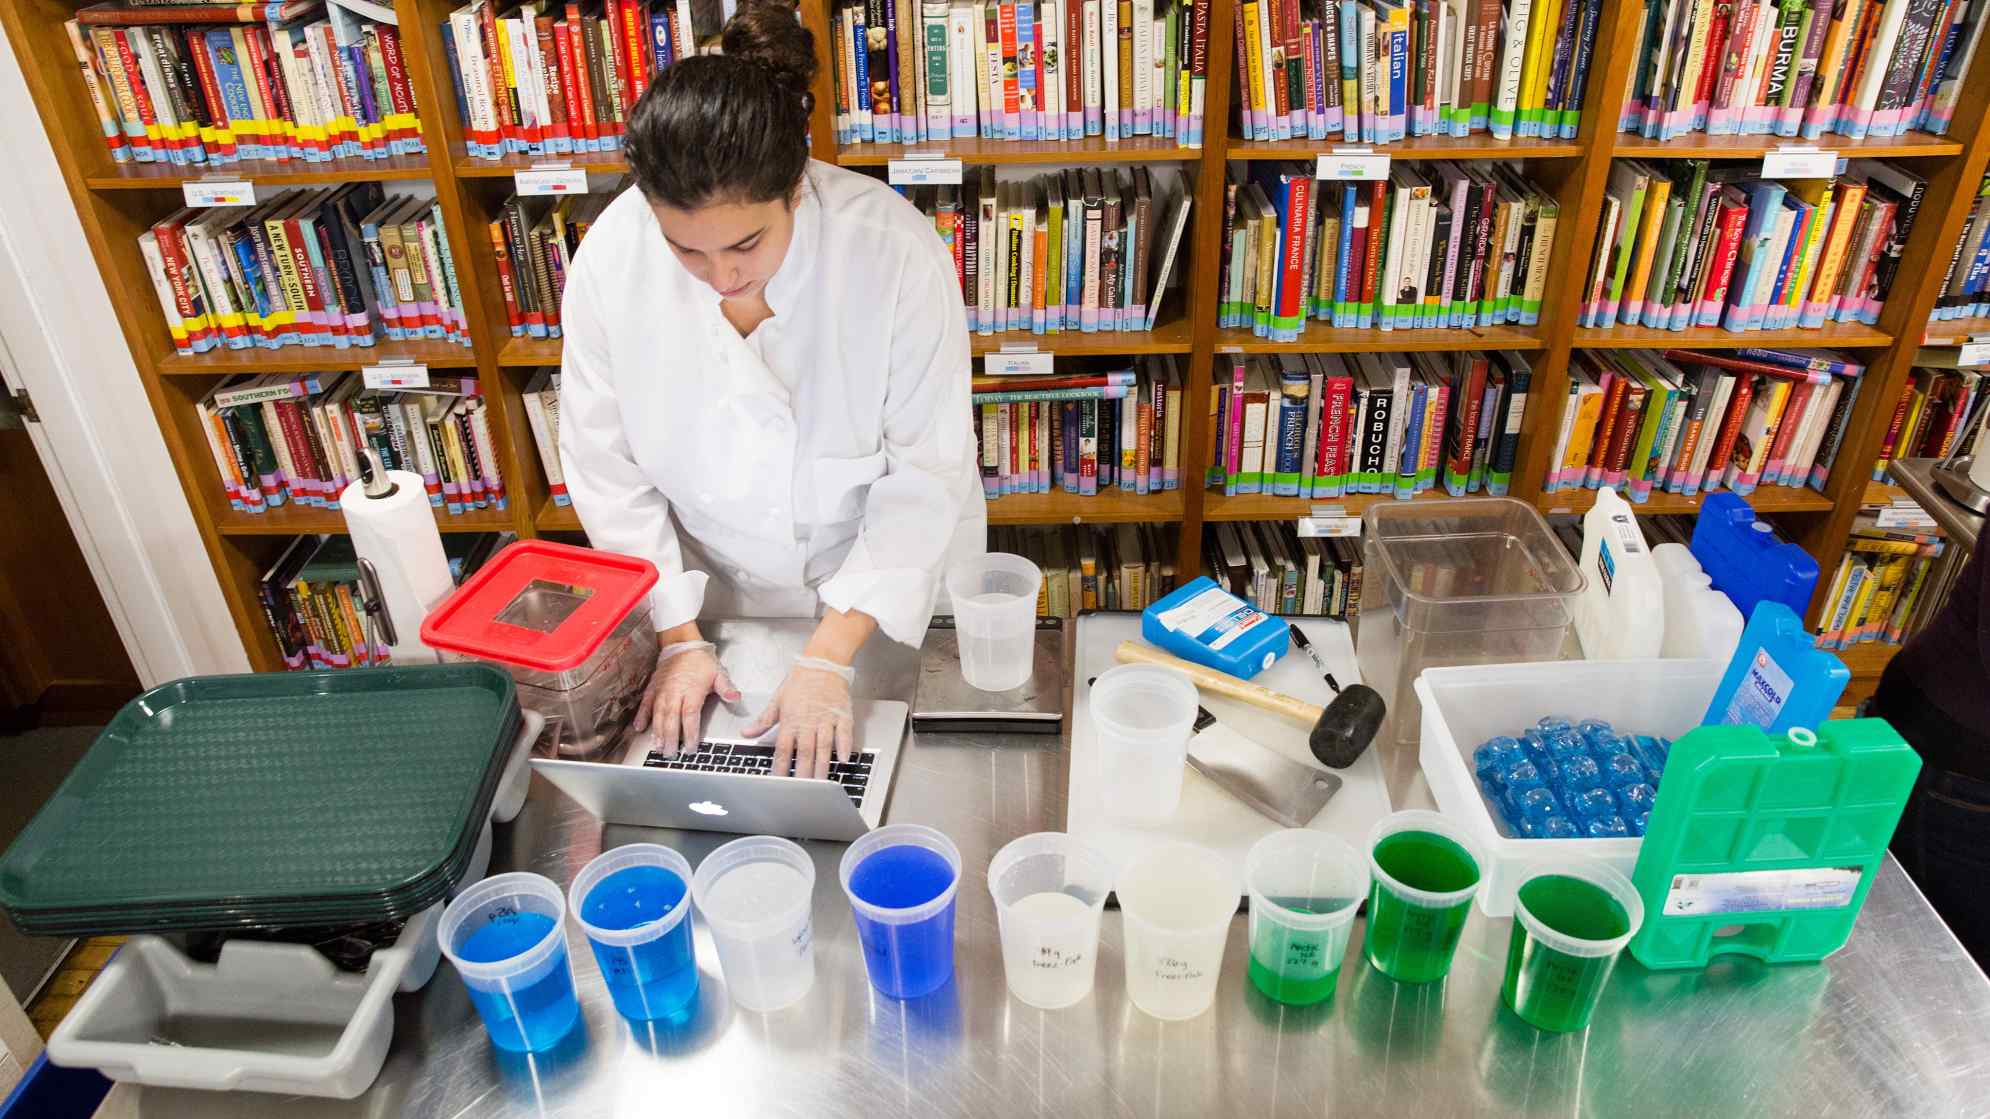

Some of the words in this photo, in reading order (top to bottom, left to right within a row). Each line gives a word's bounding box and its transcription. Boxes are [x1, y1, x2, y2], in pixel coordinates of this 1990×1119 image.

[624, 8, 636, 37] ANDREW
[1196, 2, 1208, 34] PASTA
[1488, 21, 1496, 29] LA
[1515, 3, 1529, 32] FIG
[1327, 33, 1336, 60] SHAPES
[1467, 25, 1476, 43] GREAT
[1486, 30, 1495, 50] BONNE
[1512, 39, 1523, 49] &
[1943, 29, 1959, 56] HOT
[382, 33, 400, 65] WORD
[391, 66, 401, 81] OF
[1194, 39, 1206, 72] ITALIA
[1392, 33, 1404, 79] italian
[1465, 44, 1474, 64] FRENCH
[1767, 23, 1799, 97] BURMA
[548, 65, 562, 95] Recipe
[1503, 56, 1521, 106] OLIVE
[1932, 59, 1948, 87] WOK
[1292, 185, 1305, 233] CULINARIA
[1908, 185, 1925, 215] nobu
[1731, 227, 1742, 242] Key
[1735, 213, 1746, 229] The
[1011, 230, 1019, 251] Italian
[1477, 217, 1490, 257] GIRARDET
[165, 255, 179, 276] NEW
[1010, 252, 1018, 277] Cooking
[1289, 235, 1301, 271] FRANCE
[272, 232, 285, 252] NEW
[279, 254, 293, 276] TURN
[288, 281, 305, 312] SOUTH
[294, 246, 315, 298] SOUTHERN
[1107, 273, 1116, 285] My
[1366, 266, 1375, 290] FRANCE
[1719, 249, 1738, 287] Chinese
[171, 275, 185, 297] YORK
[178, 295, 192, 316] CITY
[232, 389, 269, 402] SOUTHERN
[1327, 391, 1344, 443] FRENCH
[1695, 406, 1704, 420] THE
[1461, 434, 1474, 461] FRANCE
